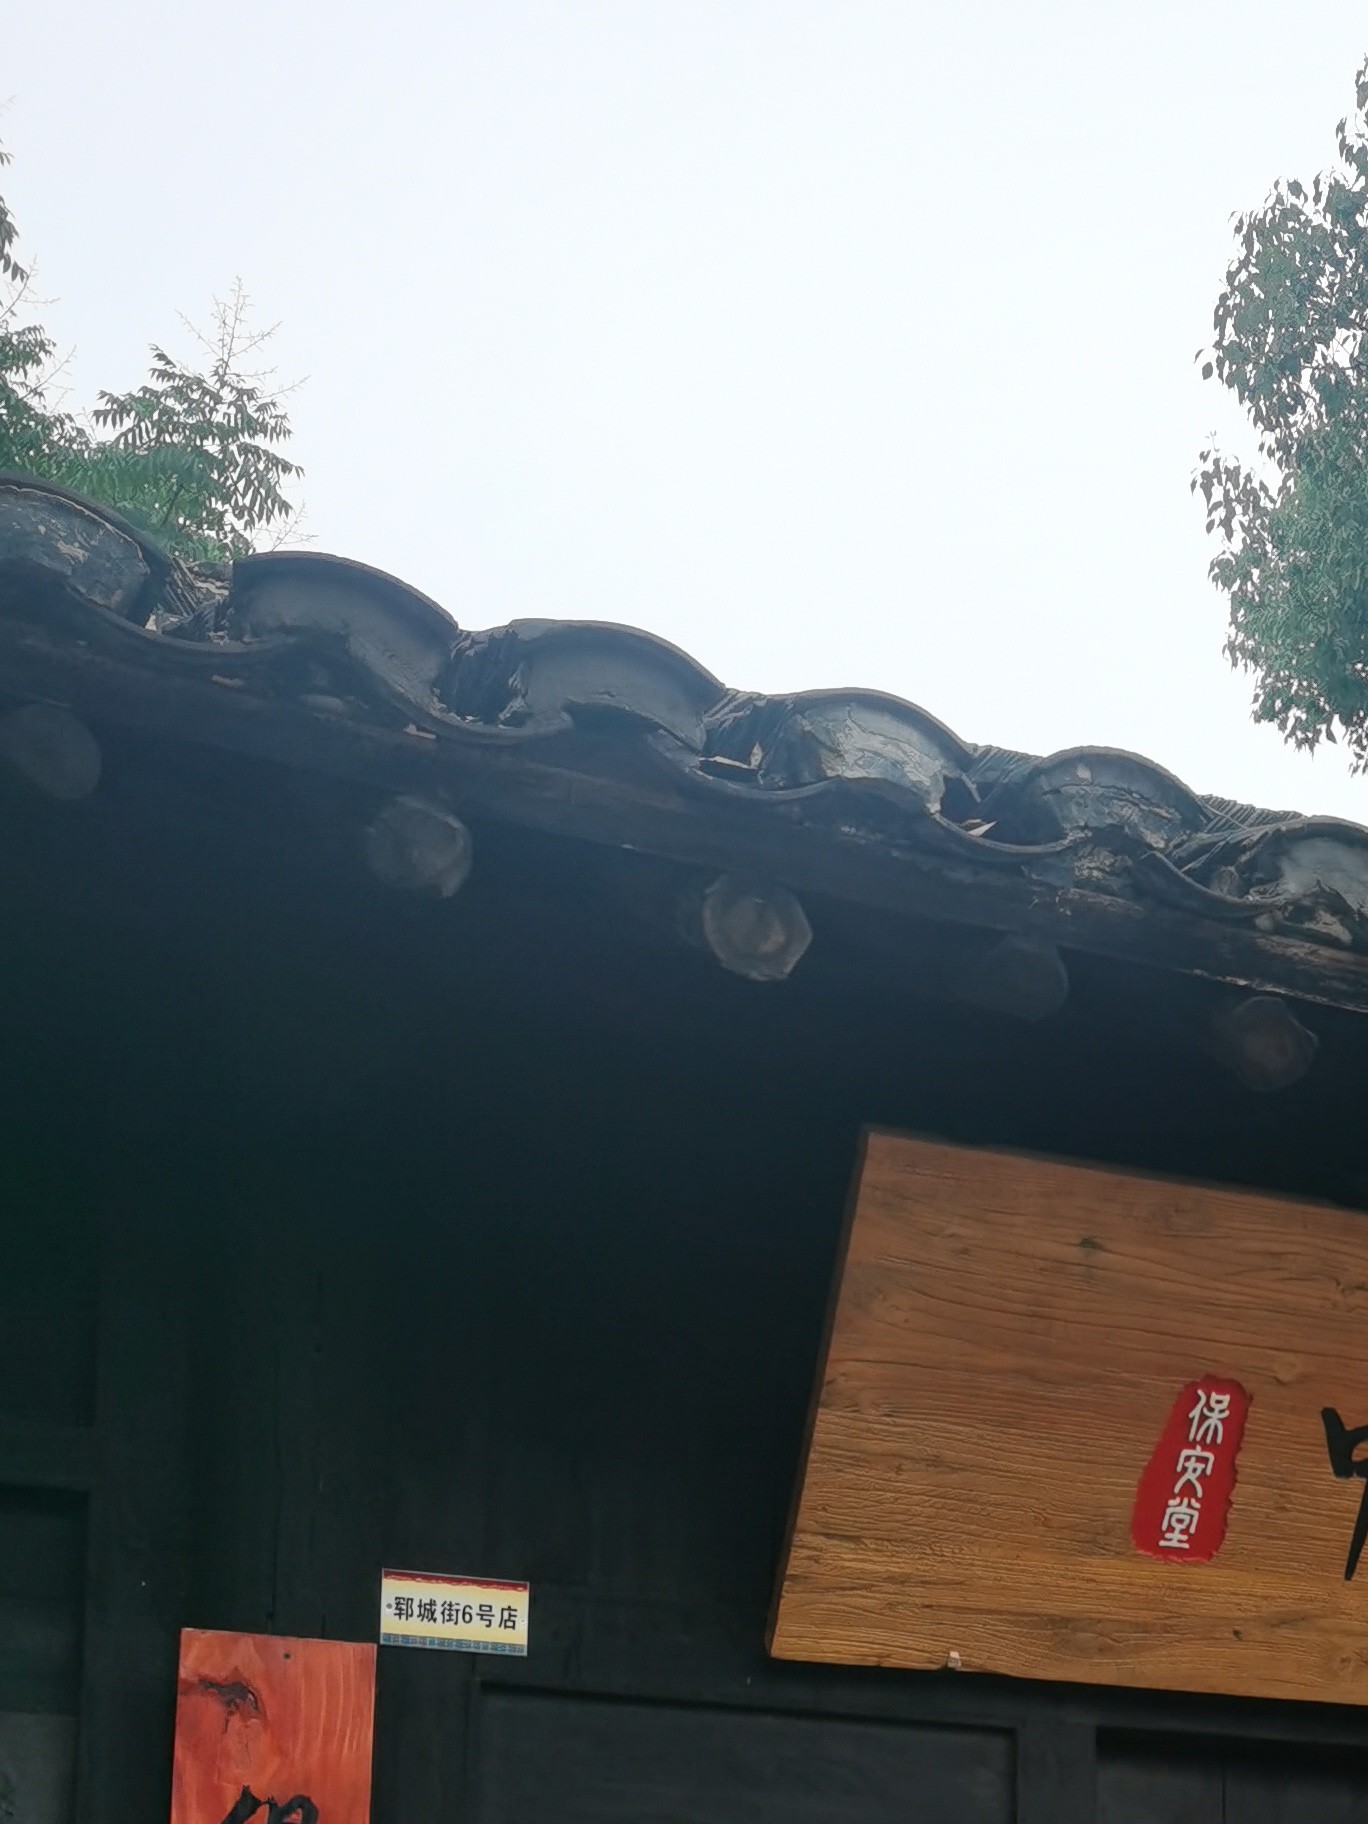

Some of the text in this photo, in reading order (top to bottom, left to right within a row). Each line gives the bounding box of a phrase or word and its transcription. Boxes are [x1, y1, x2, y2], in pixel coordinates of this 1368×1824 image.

[1158, 1389, 1231, 1549] 保安堂
[393, 1596, 518, 1630] 郓城街6号店
